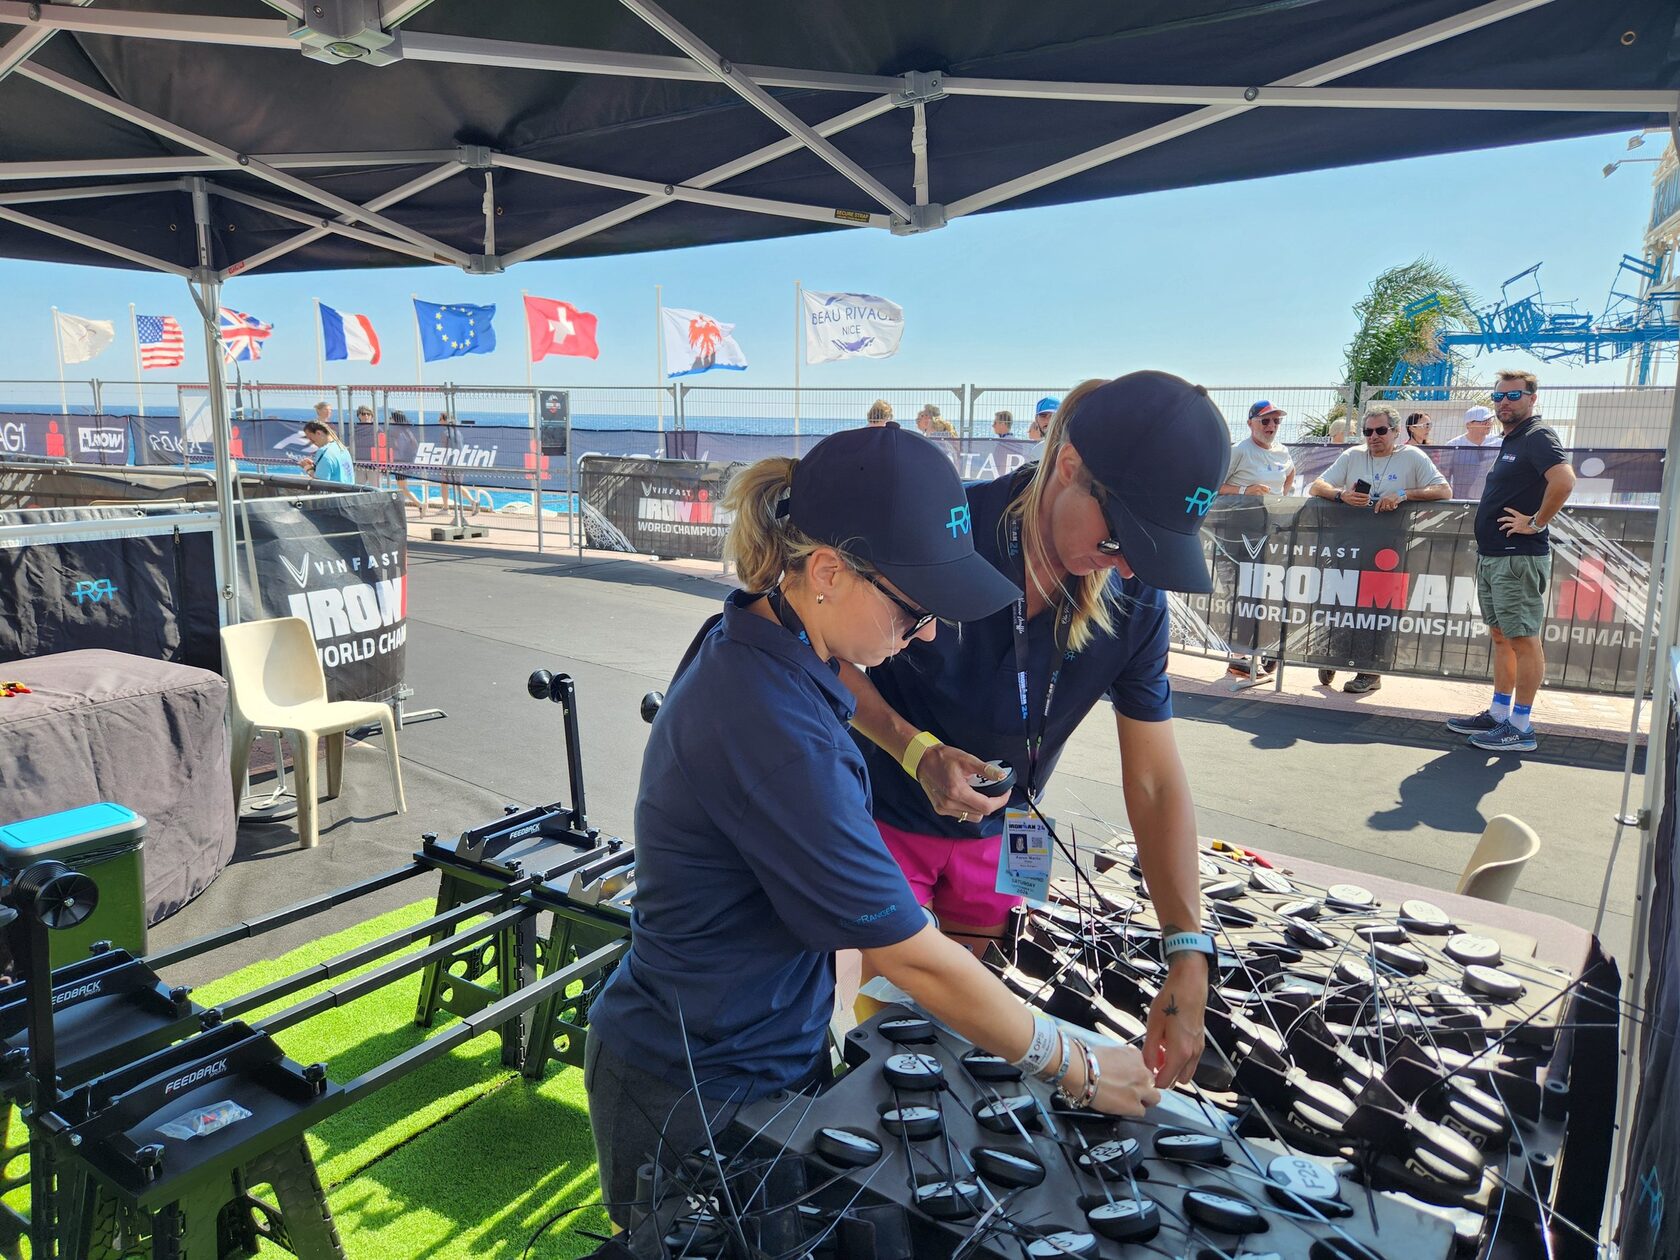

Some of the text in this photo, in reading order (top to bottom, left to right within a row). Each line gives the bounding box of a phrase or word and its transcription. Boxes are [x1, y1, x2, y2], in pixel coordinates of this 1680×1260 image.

[854, 212, 869, 220] STRAP
[811, 309, 841, 325] BEAU
[842, 325, 861, 335] NICE
[414, 443, 498, 467] Santini
[947, 453, 1026, 480] TAR
[638, 521, 671, 533] WORLD
[314, 551, 400, 576] VINFAST
[1269, 543, 1361, 560] VINFAST
[1238, 549, 1484, 616] IRONMAN
[288, 576, 407, 641] IRON
[1238, 602, 1306, 625] WORLD
[509, 822, 541, 840] FEEDBACK
[51, 980, 101, 1006] EEDBACK
[165, 1057, 228, 1095] FEEDBACK
[1292, 1159, 1326, 1189] F29
